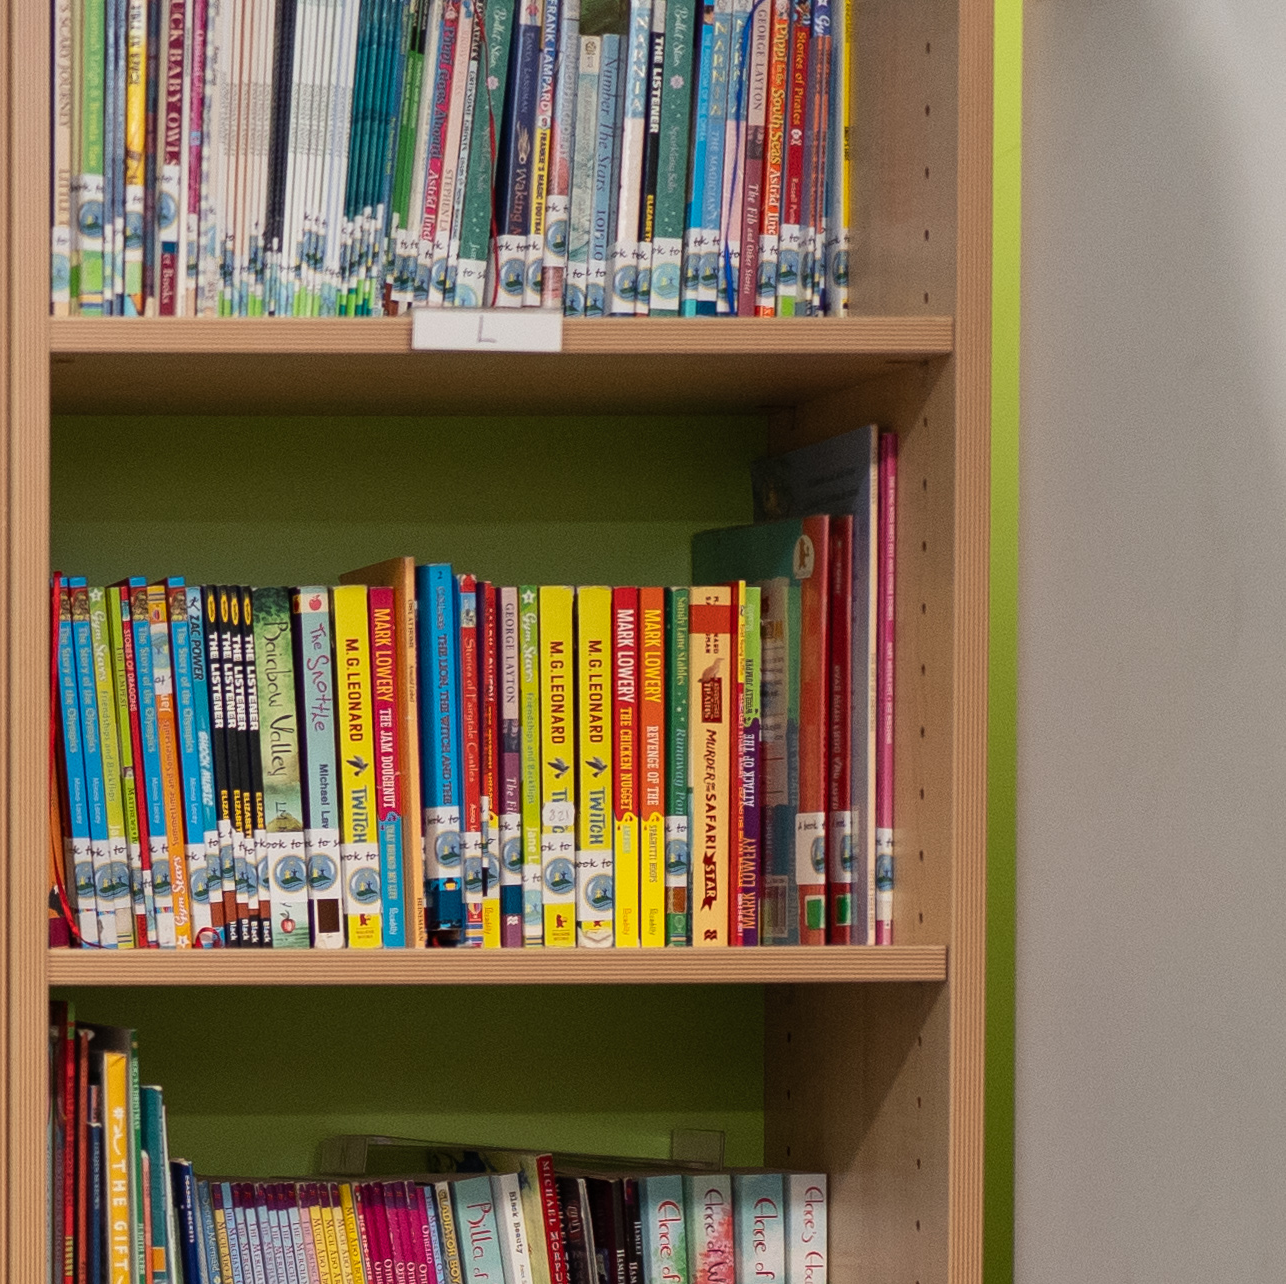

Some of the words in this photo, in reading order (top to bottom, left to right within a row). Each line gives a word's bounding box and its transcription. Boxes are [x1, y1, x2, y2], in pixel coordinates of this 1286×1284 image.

[439, 23, 454, 63] Pippi
[655, 36, 664, 65] THE
[755, 8, 768, 58] GEORGE
[167, 51, 183, 107] BABY
[540, 47, 556, 111] LAMPARD
[632, 15, 650, 113] NARNIA
[600, 55, 618, 117] Number
[648, 66, 664, 134] LISTENER
[752, 63, 766, 112] LAYTON
[770, 87, 784, 127] South
[429, 107, 446, 158] Aboard
[599, 118, 613, 142] The
[768, 131, 782, 165] Seas
[424, 168, 439, 207] Astrid
[595, 146, 612, 196] Stars
[767, 167, 779, 206] Astrid
[747, 183, 760, 205] The
[476, 315, 498, 345] L
[189, 614, 201, 638] ZAC
[208, 631, 220, 661] THE
[308, 623, 326, 653] The
[373, 608, 390, 646] MARK
[505, 601, 515, 651] GEORGE
[616, 608, 634, 648] MARK
[191, 639, 205, 681] POWER
[244, 633, 256, 663] THE
[209, 663, 224, 730] LISTENER
[375, 648, 394, 703] LOWERY
[505, 652, 516, 705] LAYTON
[616, 651, 635, 704] LOWERY
[246, 665, 260, 732] LISTENER
[379, 707, 391, 727] THE
[620, 706, 631, 726] THE
[267, 712, 293, 778] Valley
[380, 729, 393, 752] JAM
[620, 728, 631, 769] CHICKEN
[647, 726, 658, 768] REVENGE
[702, 728, 717, 780] MURDER
[318, 763, 330, 799] Michael
[381, 754, 397, 808] DOUGHNUT
[620, 773, 631, 810] NUGGET
[647, 771, 658, 784] OF
[647, 786, 658, 806] THE
[705, 793, 717, 851] SAFARI
[705, 862, 717, 898] STAR
[112, 1160, 127, 1207] THE
[541, 1160, 558, 1226] MICHAEL
[436, 1188, 457, 1257] GLADIATOR
[657, 1199, 683, 1258] Anne
[801, 1185, 824, 1244] Anne's
[112, 1219, 129, 1272] GIFT
